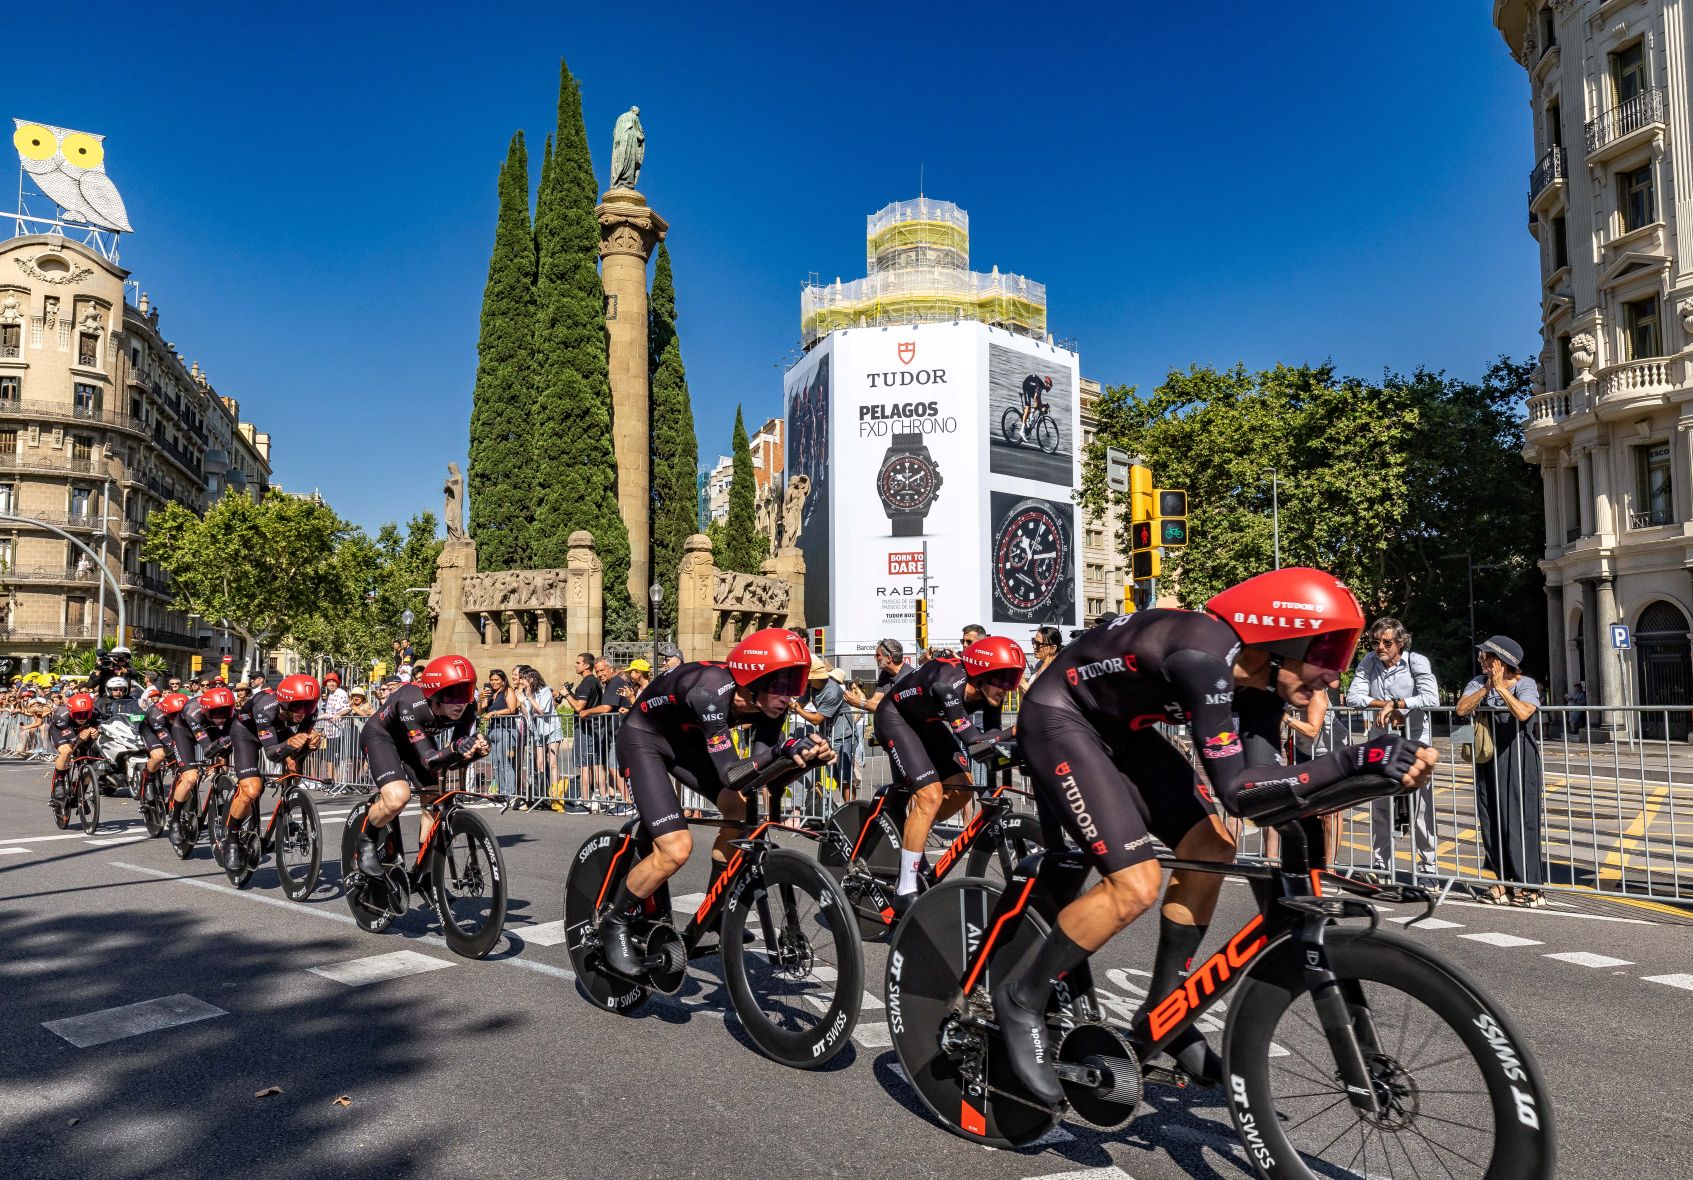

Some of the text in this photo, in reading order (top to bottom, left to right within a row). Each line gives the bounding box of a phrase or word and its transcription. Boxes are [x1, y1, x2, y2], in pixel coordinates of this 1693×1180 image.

[867, 369, 947, 388] TUDOR
[859, 401, 939, 420] PELAGOS
[859, 417, 957, 437] FXD CHRONO
[890, 553, 924, 562] BORN TO
[890, 561, 924, 573] DARE
[876, 585, 939, 597] RABAT
[1281, 601, 1315, 611] TUDOR
[1233, 612, 1324, 630] OAKLEY
[1614, 628, 1626, 647] P
[1078, 657, 1126, 681] TUDOR
[898, 687, 918, 700] TUDOR
[943, 698, 960, 708] MSC
[1205, 691, 1234, 705] MSC
[702, 712, 724, 722] MSC
[1061, 775, 1099, 841] TUDOR
[651, 812, 680, 828] sportful
[579, 836, 611, 864] DT SWISS
[888, 833, 900, 849] DT
[935, 808, 984, 878] BMC
[696, 848, 743, 925] BMC
[1148, 914, 1269, 1041] BMC
[607, 985, 641, 1009] DT SWISS
[889, 950, 905, 1034] DT SWISS
[812, 1009, 847, 1058] DT SWISS
[1030, 1026, 1045, 1064] sportful
[1472, 1013, 1540, 1131] DT SWISS
[1230, 1073, 1276, 1170] DT SWISS
